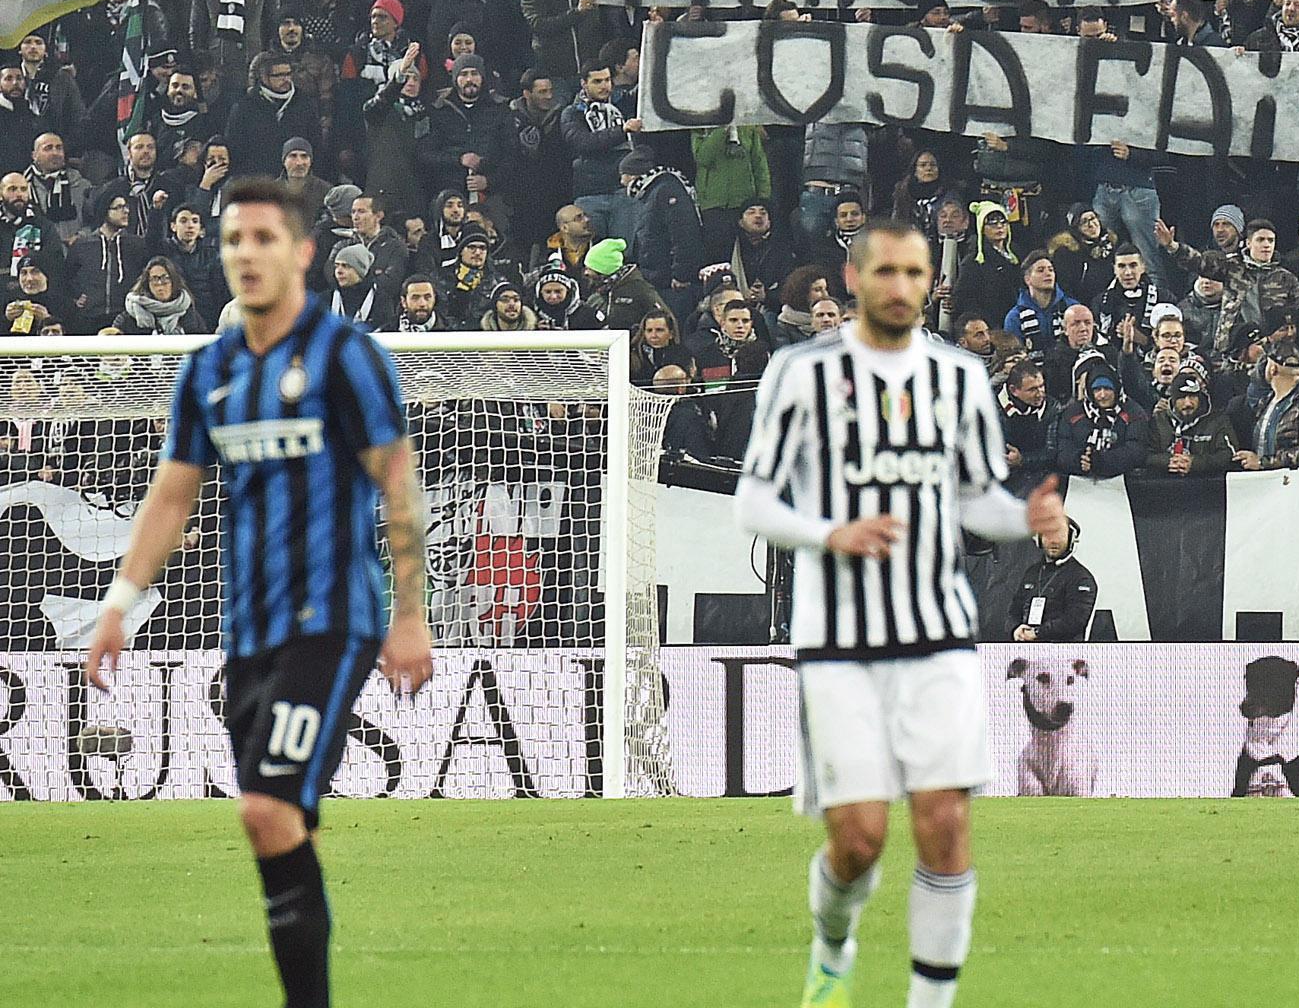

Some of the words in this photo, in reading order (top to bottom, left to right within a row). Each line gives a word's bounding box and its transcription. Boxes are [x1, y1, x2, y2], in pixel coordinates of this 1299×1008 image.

[648, 20, 1032, 139] COSA
[844, 444, 944, 485] Jeep
[271, 701, 321, 763] 10
